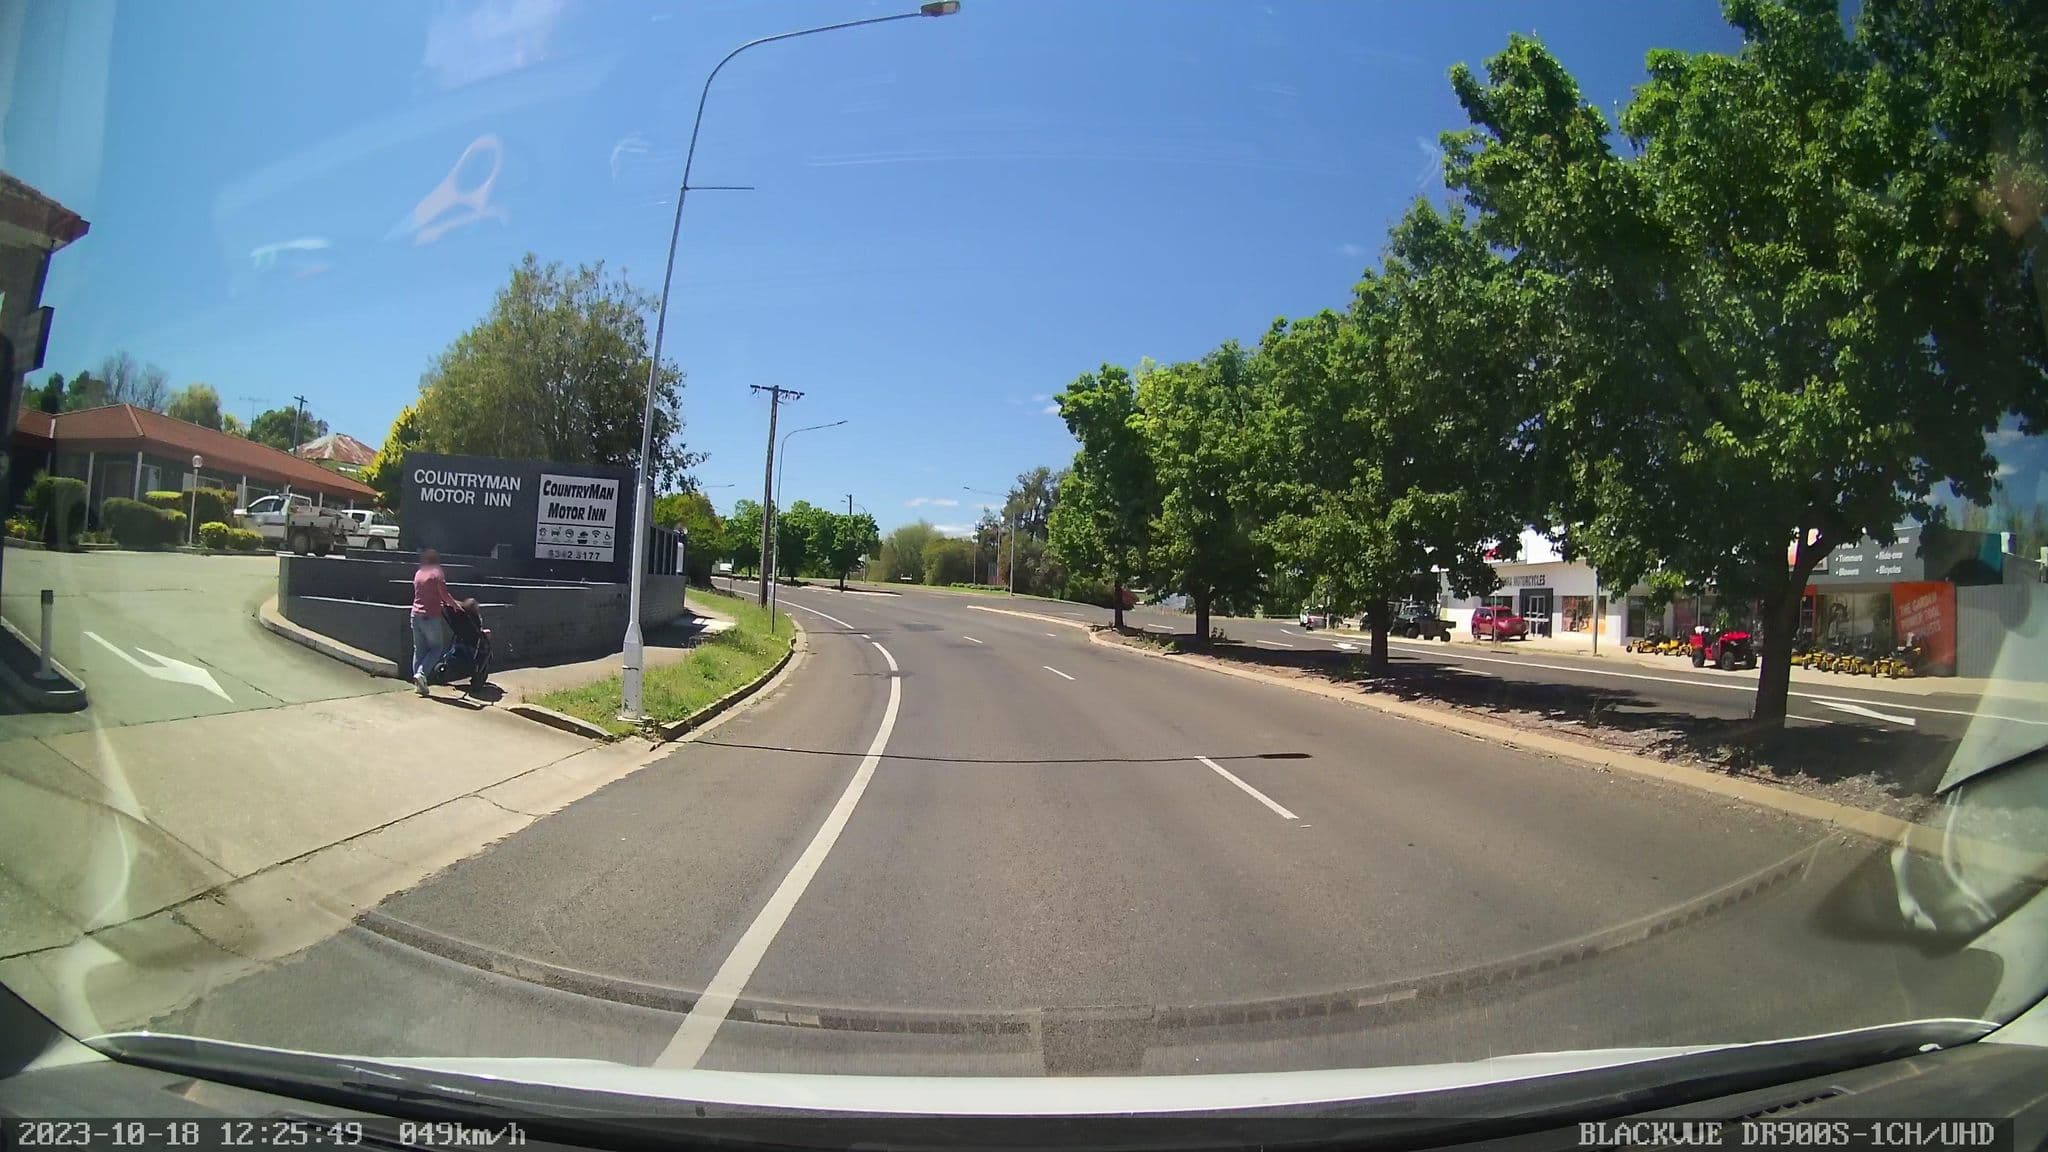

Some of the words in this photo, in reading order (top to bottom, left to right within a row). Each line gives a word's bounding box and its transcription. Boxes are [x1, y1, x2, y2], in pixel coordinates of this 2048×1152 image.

[414, 469, 521, 491] COUNTRYMAN
[420, 487, 475, 505] MOTOR
[484, 491, 512, 507] INN
